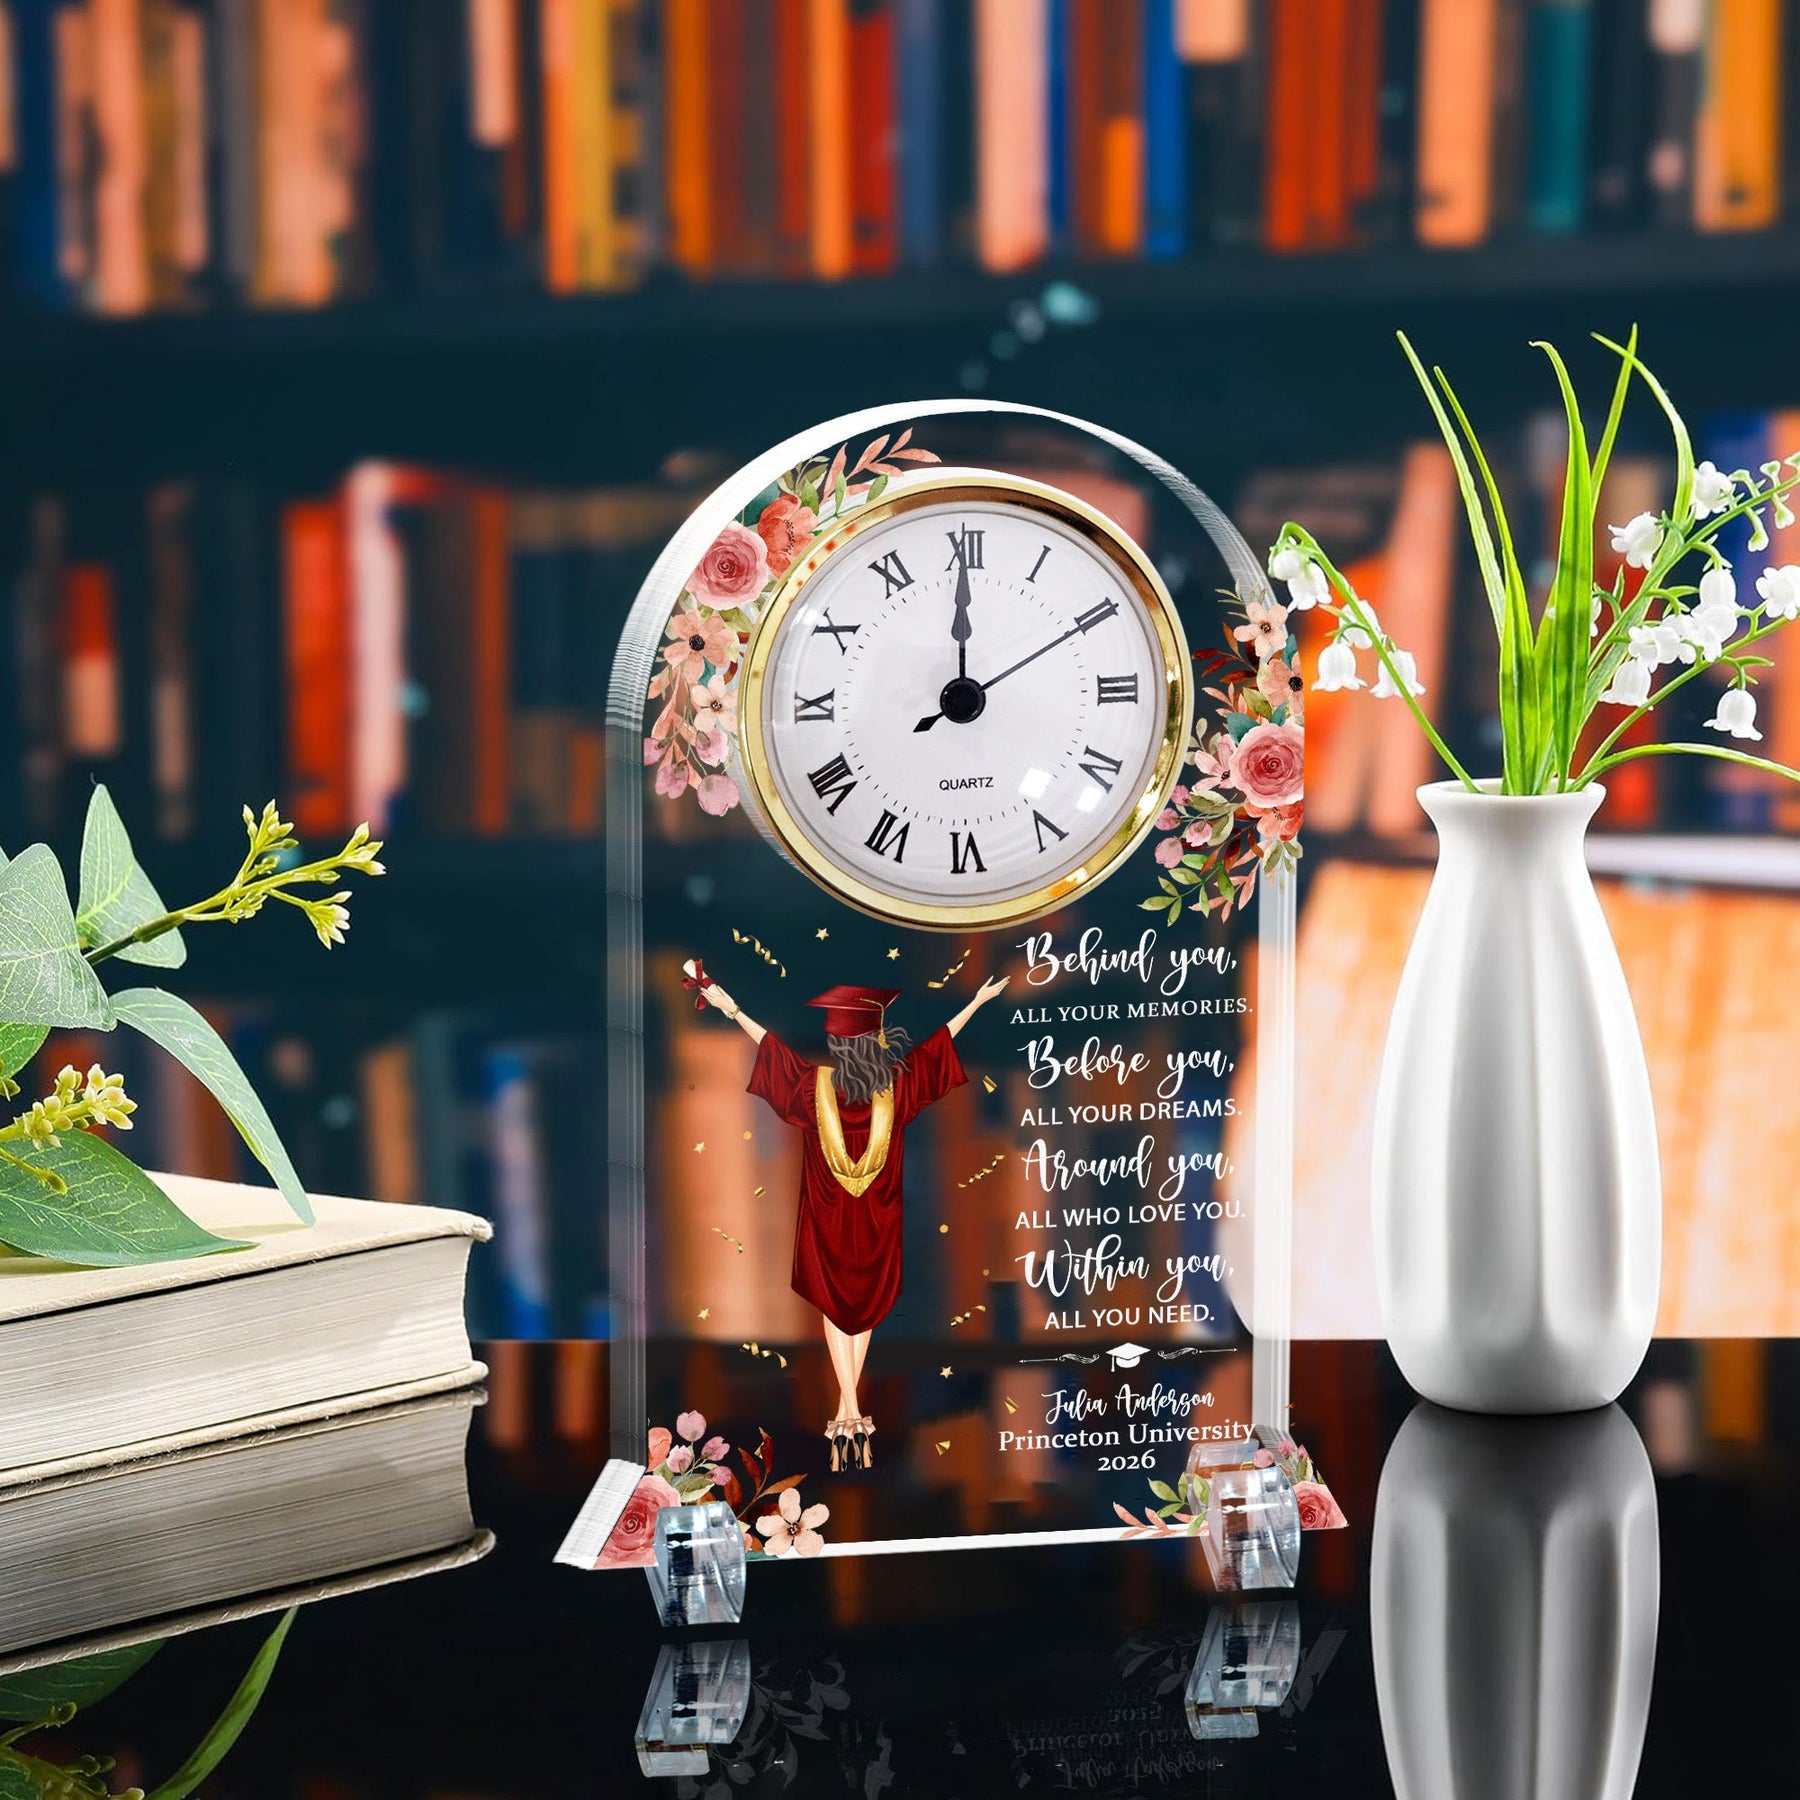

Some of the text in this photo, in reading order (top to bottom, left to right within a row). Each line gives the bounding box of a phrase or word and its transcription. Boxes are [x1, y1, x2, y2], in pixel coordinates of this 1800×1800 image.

[945, 530, 985, 571] XII
[1026, 545, 1052, 583] I
[868, 550, 915, 599] XI
[811, 607, 861, 655] X
[1074, 597, 1119, 636] II
[795, 688, 835, 724] IX
[1097, 673, 1138, 706] III
[807, 752, 858, 816] VIII
[939, 777, 994, 791] QUARTZ
[1078, 745, 1123, 793] IV
[864, 809, 911, 863] VII
[1033, 809, 1069, 853] V
[950, 831, 987, 874] VI
[1016, 927, 1238, 996] Behind you,
[1010, 998, 1253, 1024] ALL YOUR MEMORIES.
[1017, 1035, 1235, 1099] Before you,
[1020, 1099, 1243, 1126] ALL YOUR DREAMS.
[1021, 1135, 1235, 1201] Around you,
[1014, 1200, 1246, 1230] ALL WHO LOVE YOU.
[1014, 1234, 1235, 1303] Within you,
[1044, 1304, 1215, 1330] ALL YOU NEED.
[1041, 1382, 1215, 1425] Julia Anderson
[999, 1419, 1255, 1451] Princeton University
[1097, 1449, 1156, 1471] 2026
